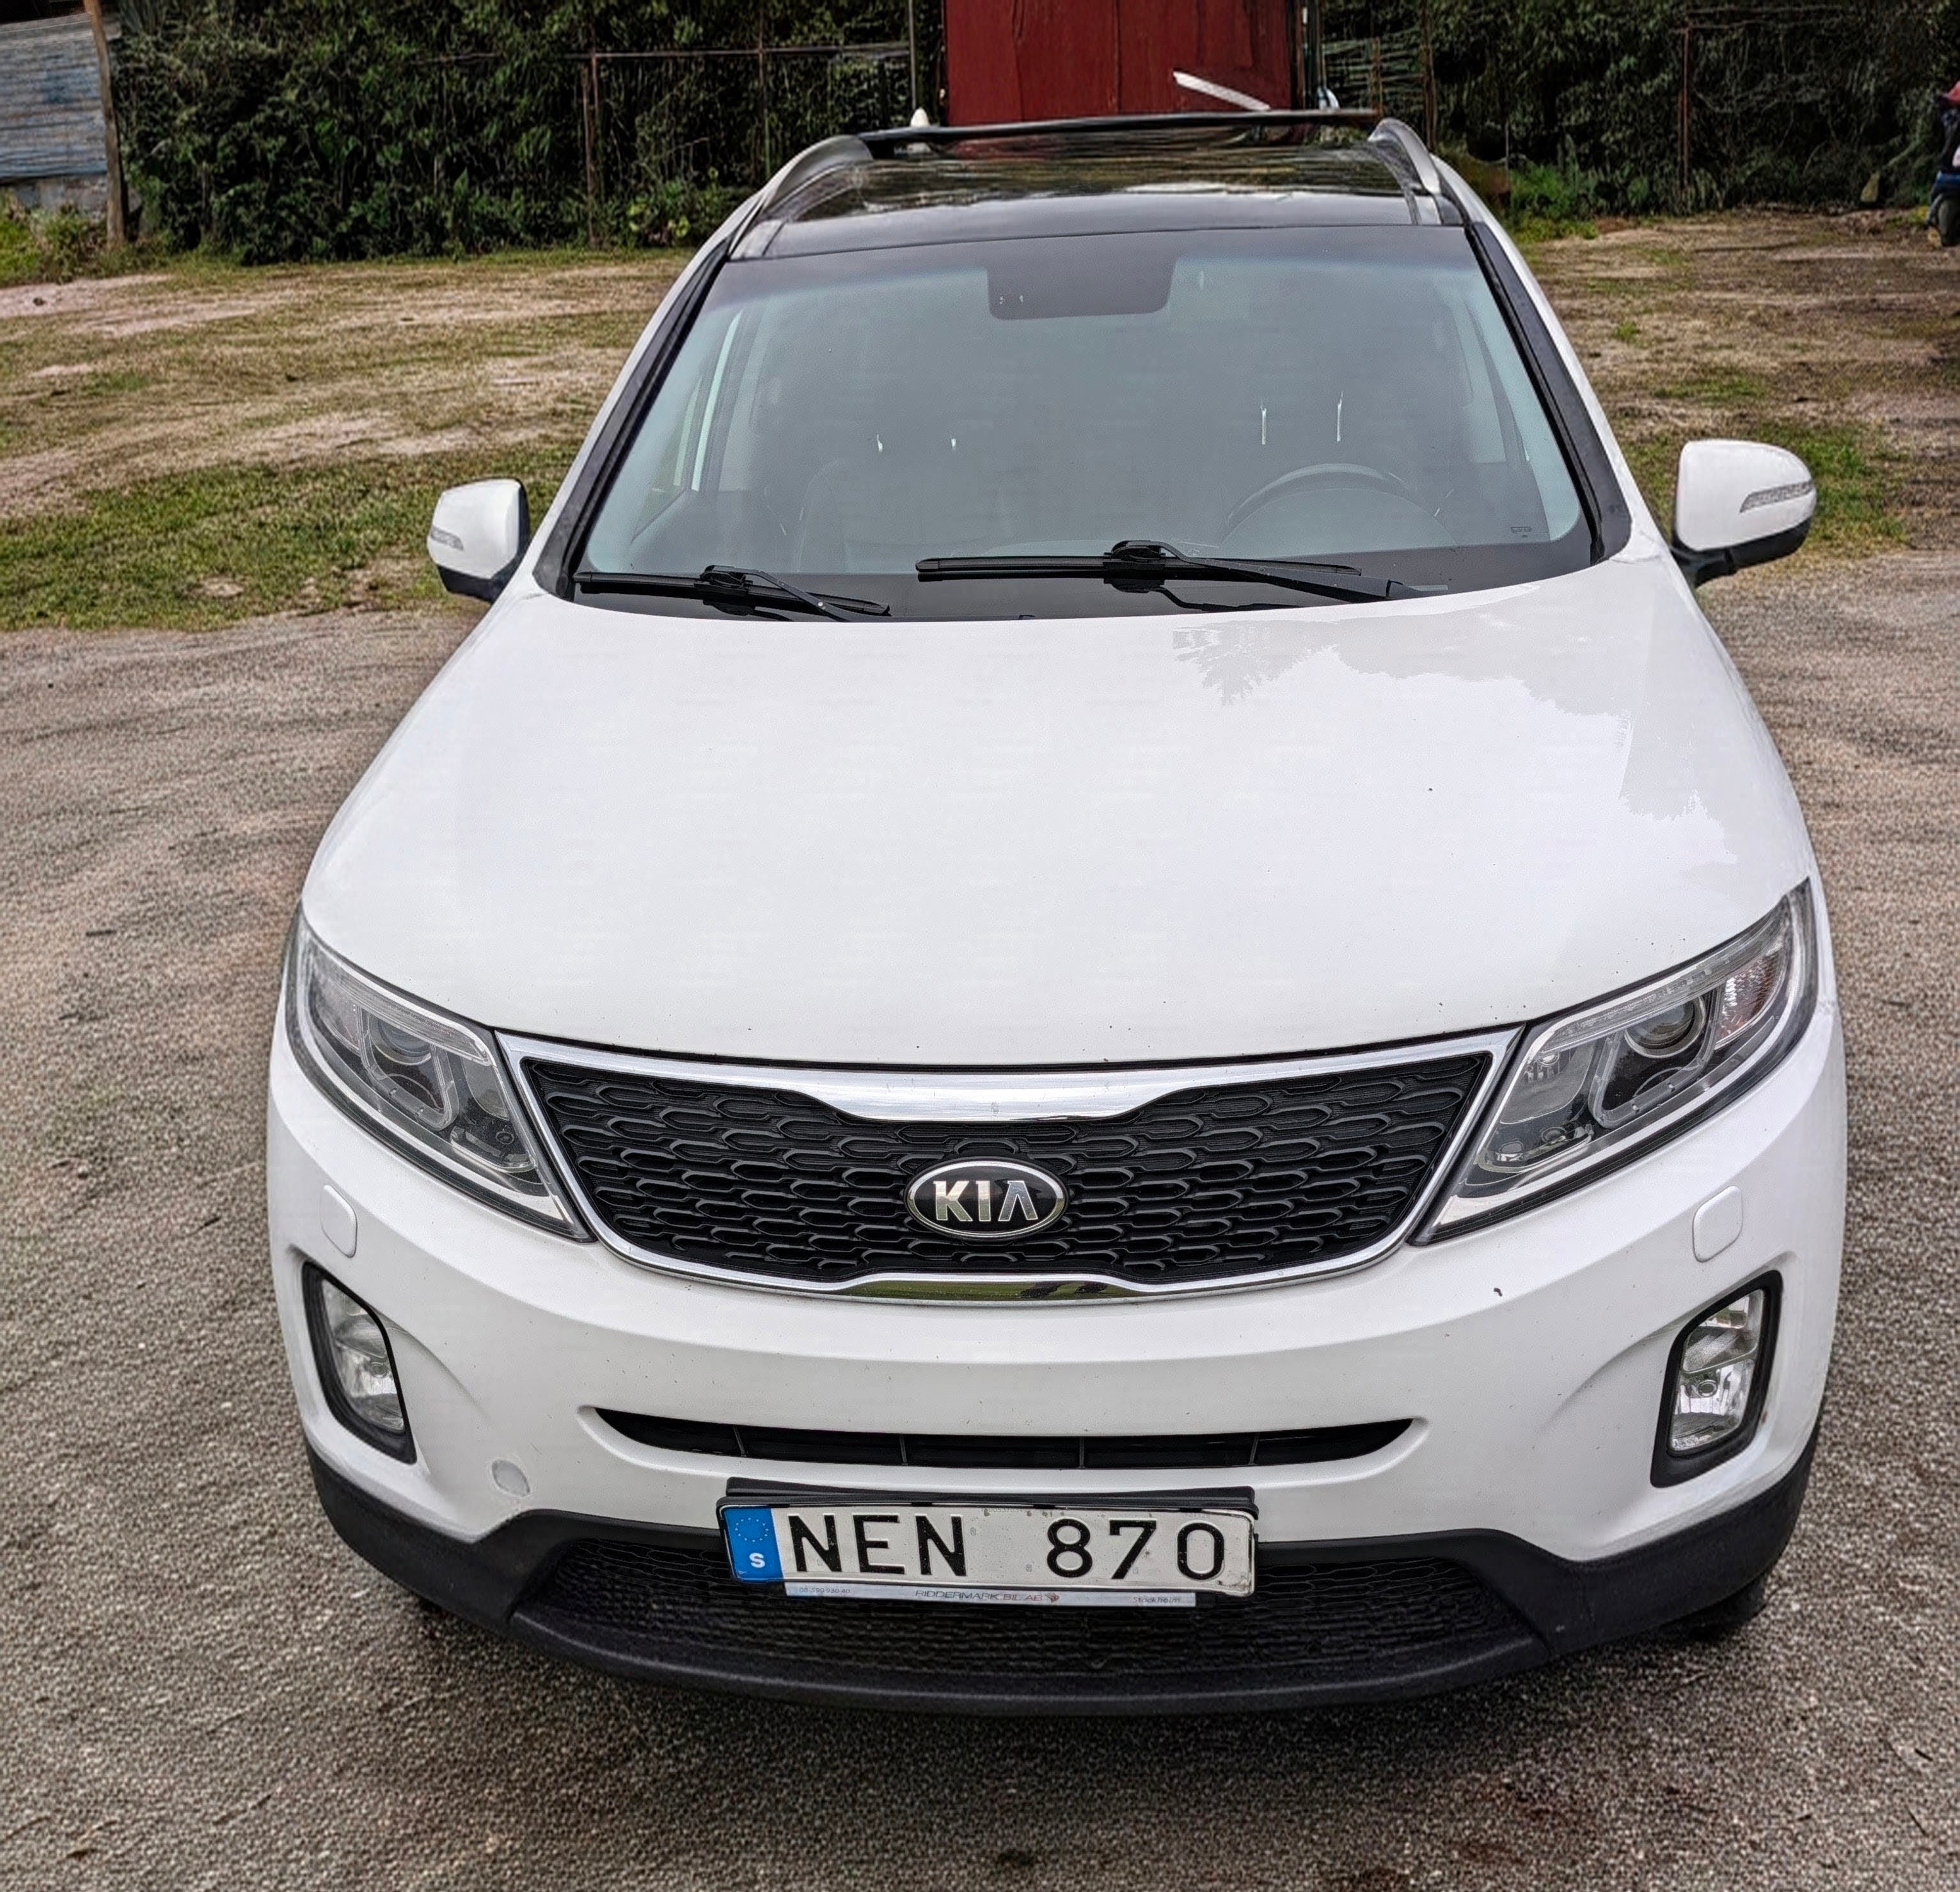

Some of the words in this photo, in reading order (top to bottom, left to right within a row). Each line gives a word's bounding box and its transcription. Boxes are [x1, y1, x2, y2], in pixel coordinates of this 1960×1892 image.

[933, 1181, 1038, 1221] KIA
[749, 1552, 766, 1568] S
[787, 1514, 967, 1577] NEN
[1047, 1517, 1224, 1581] 870
[915, 1590, 1000, 1600] RIDDERMARK
